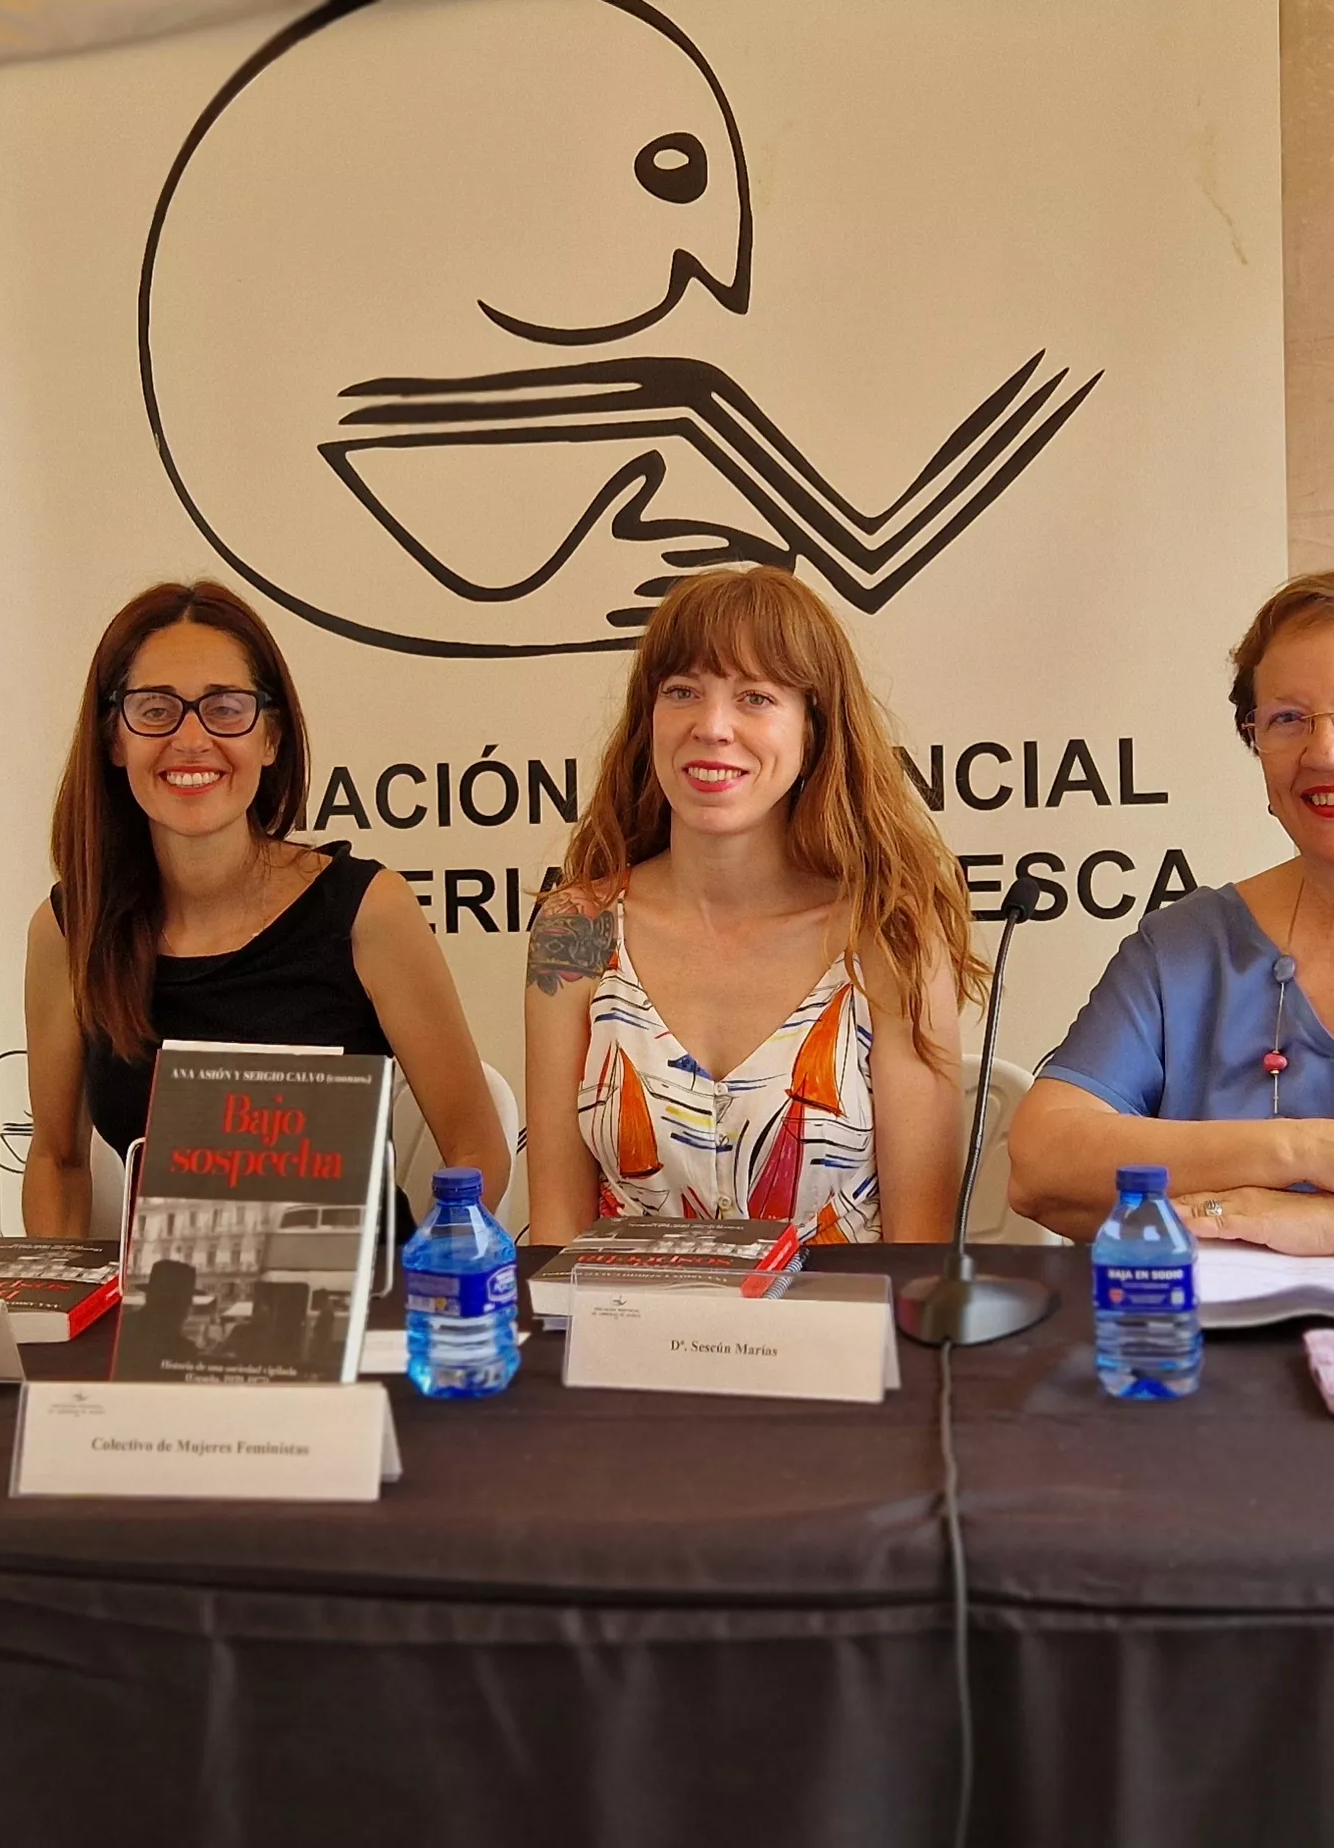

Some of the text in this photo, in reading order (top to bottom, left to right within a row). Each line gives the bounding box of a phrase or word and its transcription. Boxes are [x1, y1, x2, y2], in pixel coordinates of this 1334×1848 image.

[171, 1068, 194, 1079] ANA
[234, 1070, 241, 1080] Y
[243, 1070, 284, 1081] SERGIO
[286, 1071, 325, 1083] CALVO
[221, 1093, 305, 1147] Bajo
[170, 1139, 343, 1189] sospecha
[735, 1343, 778, 1356] Marías
[91, 1437, 153, 1452] Colectivo
[156, 1439, 172, 1452] de
[176, 1439, 232, 1457] Mujeres
